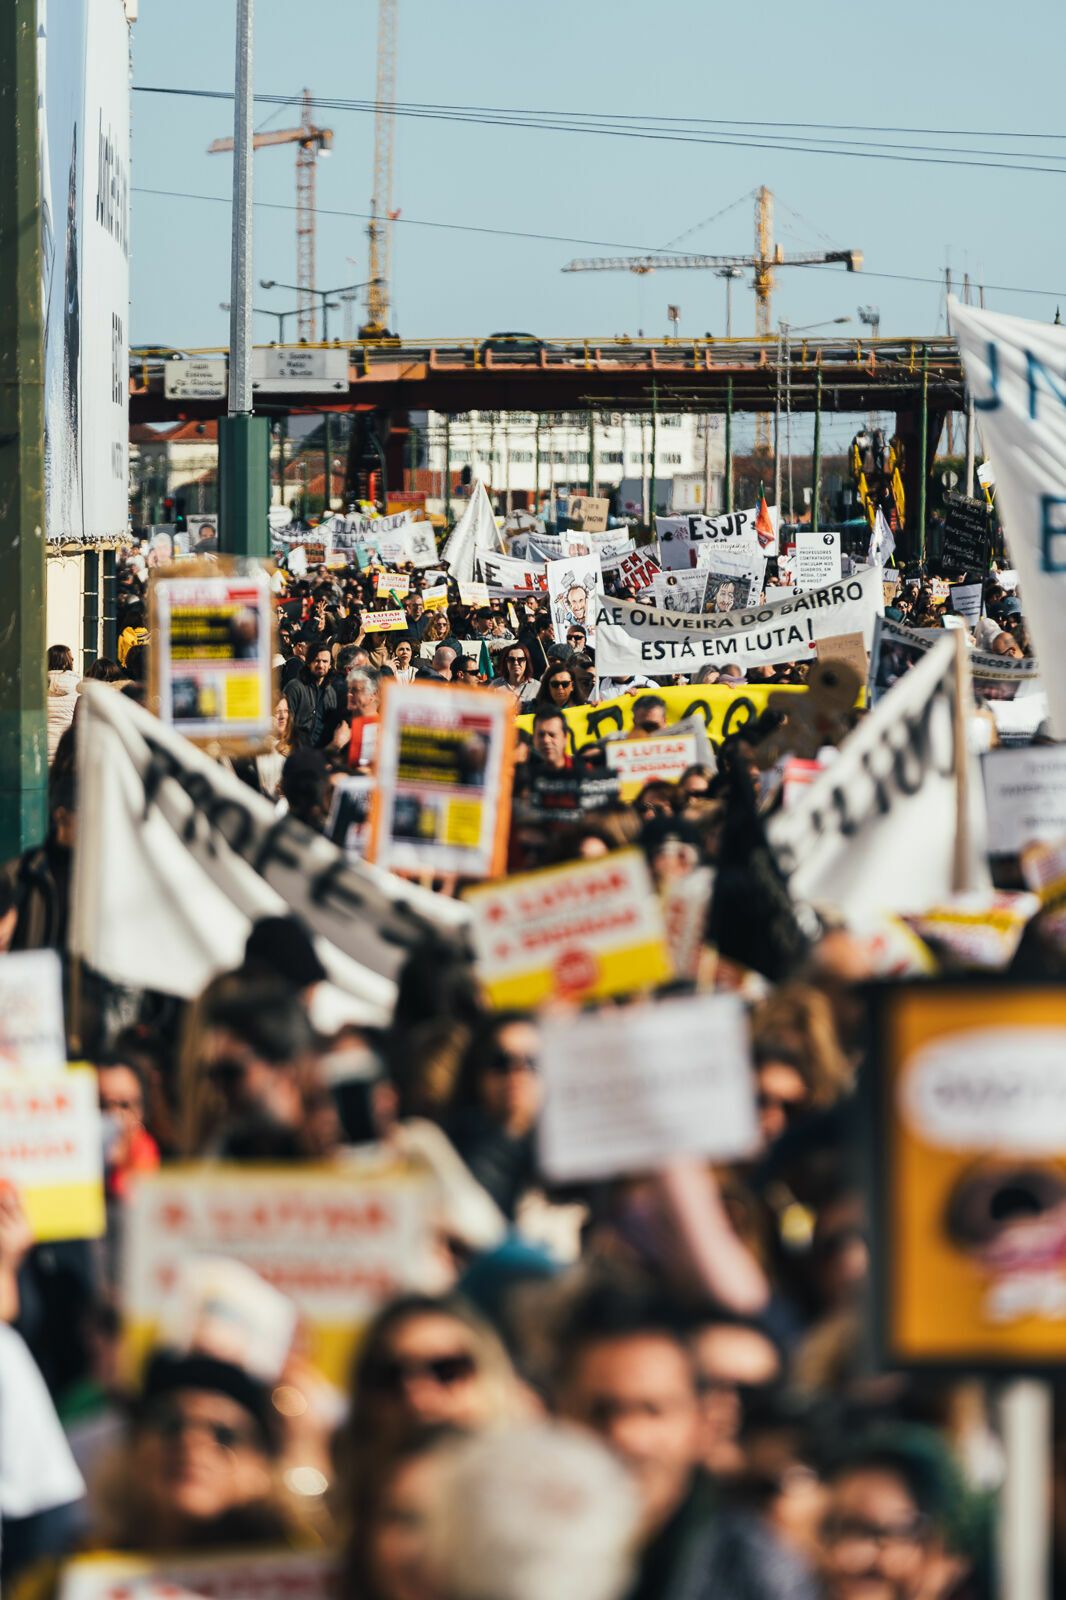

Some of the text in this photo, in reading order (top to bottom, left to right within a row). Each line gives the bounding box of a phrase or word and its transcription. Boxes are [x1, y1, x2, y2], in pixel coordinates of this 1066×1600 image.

[688, 512, 748, 541] ESJP
[620, 551, 643, 574] EM
[596, 581, 864, 629] AE OLIVEIRA DO BAIRRO
[641, 635, 695, 660] ESTÁ
[704, 637, 737, 656] EM
[746, 617, 816, 651] LUTA!
[615, 742, 687, 758] A LUTAR
